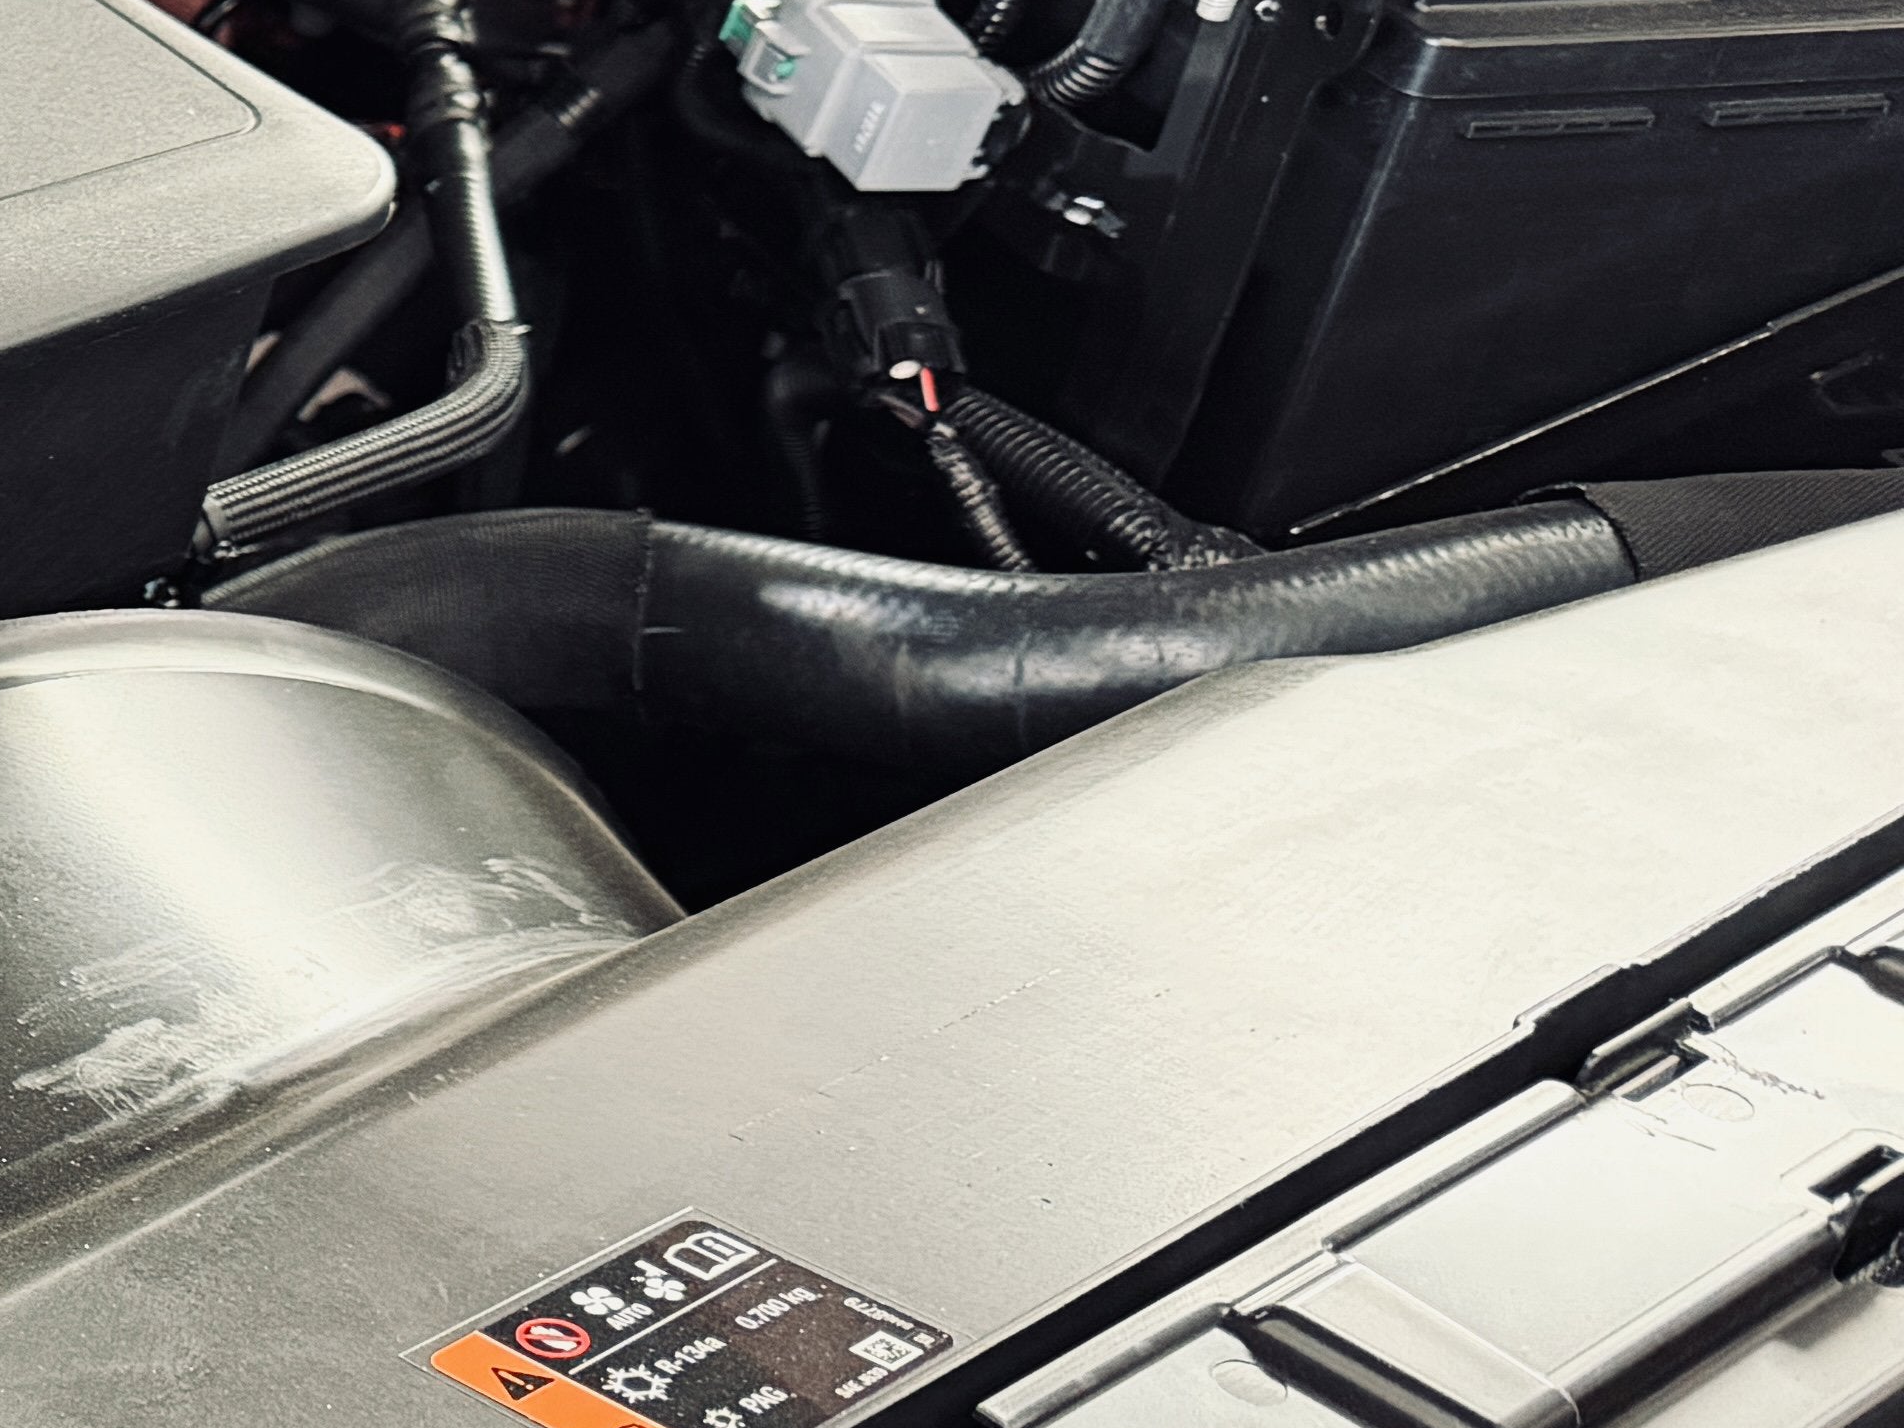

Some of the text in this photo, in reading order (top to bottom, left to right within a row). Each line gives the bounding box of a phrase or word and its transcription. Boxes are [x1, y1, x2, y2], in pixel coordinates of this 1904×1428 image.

[606, 1303, 653, 1330] AUTO
[654, 1337, 727, 1374] R-134a
[735, 1298, 791, 1329] 0.700
[739, 1386, 788, 1414] PAG
